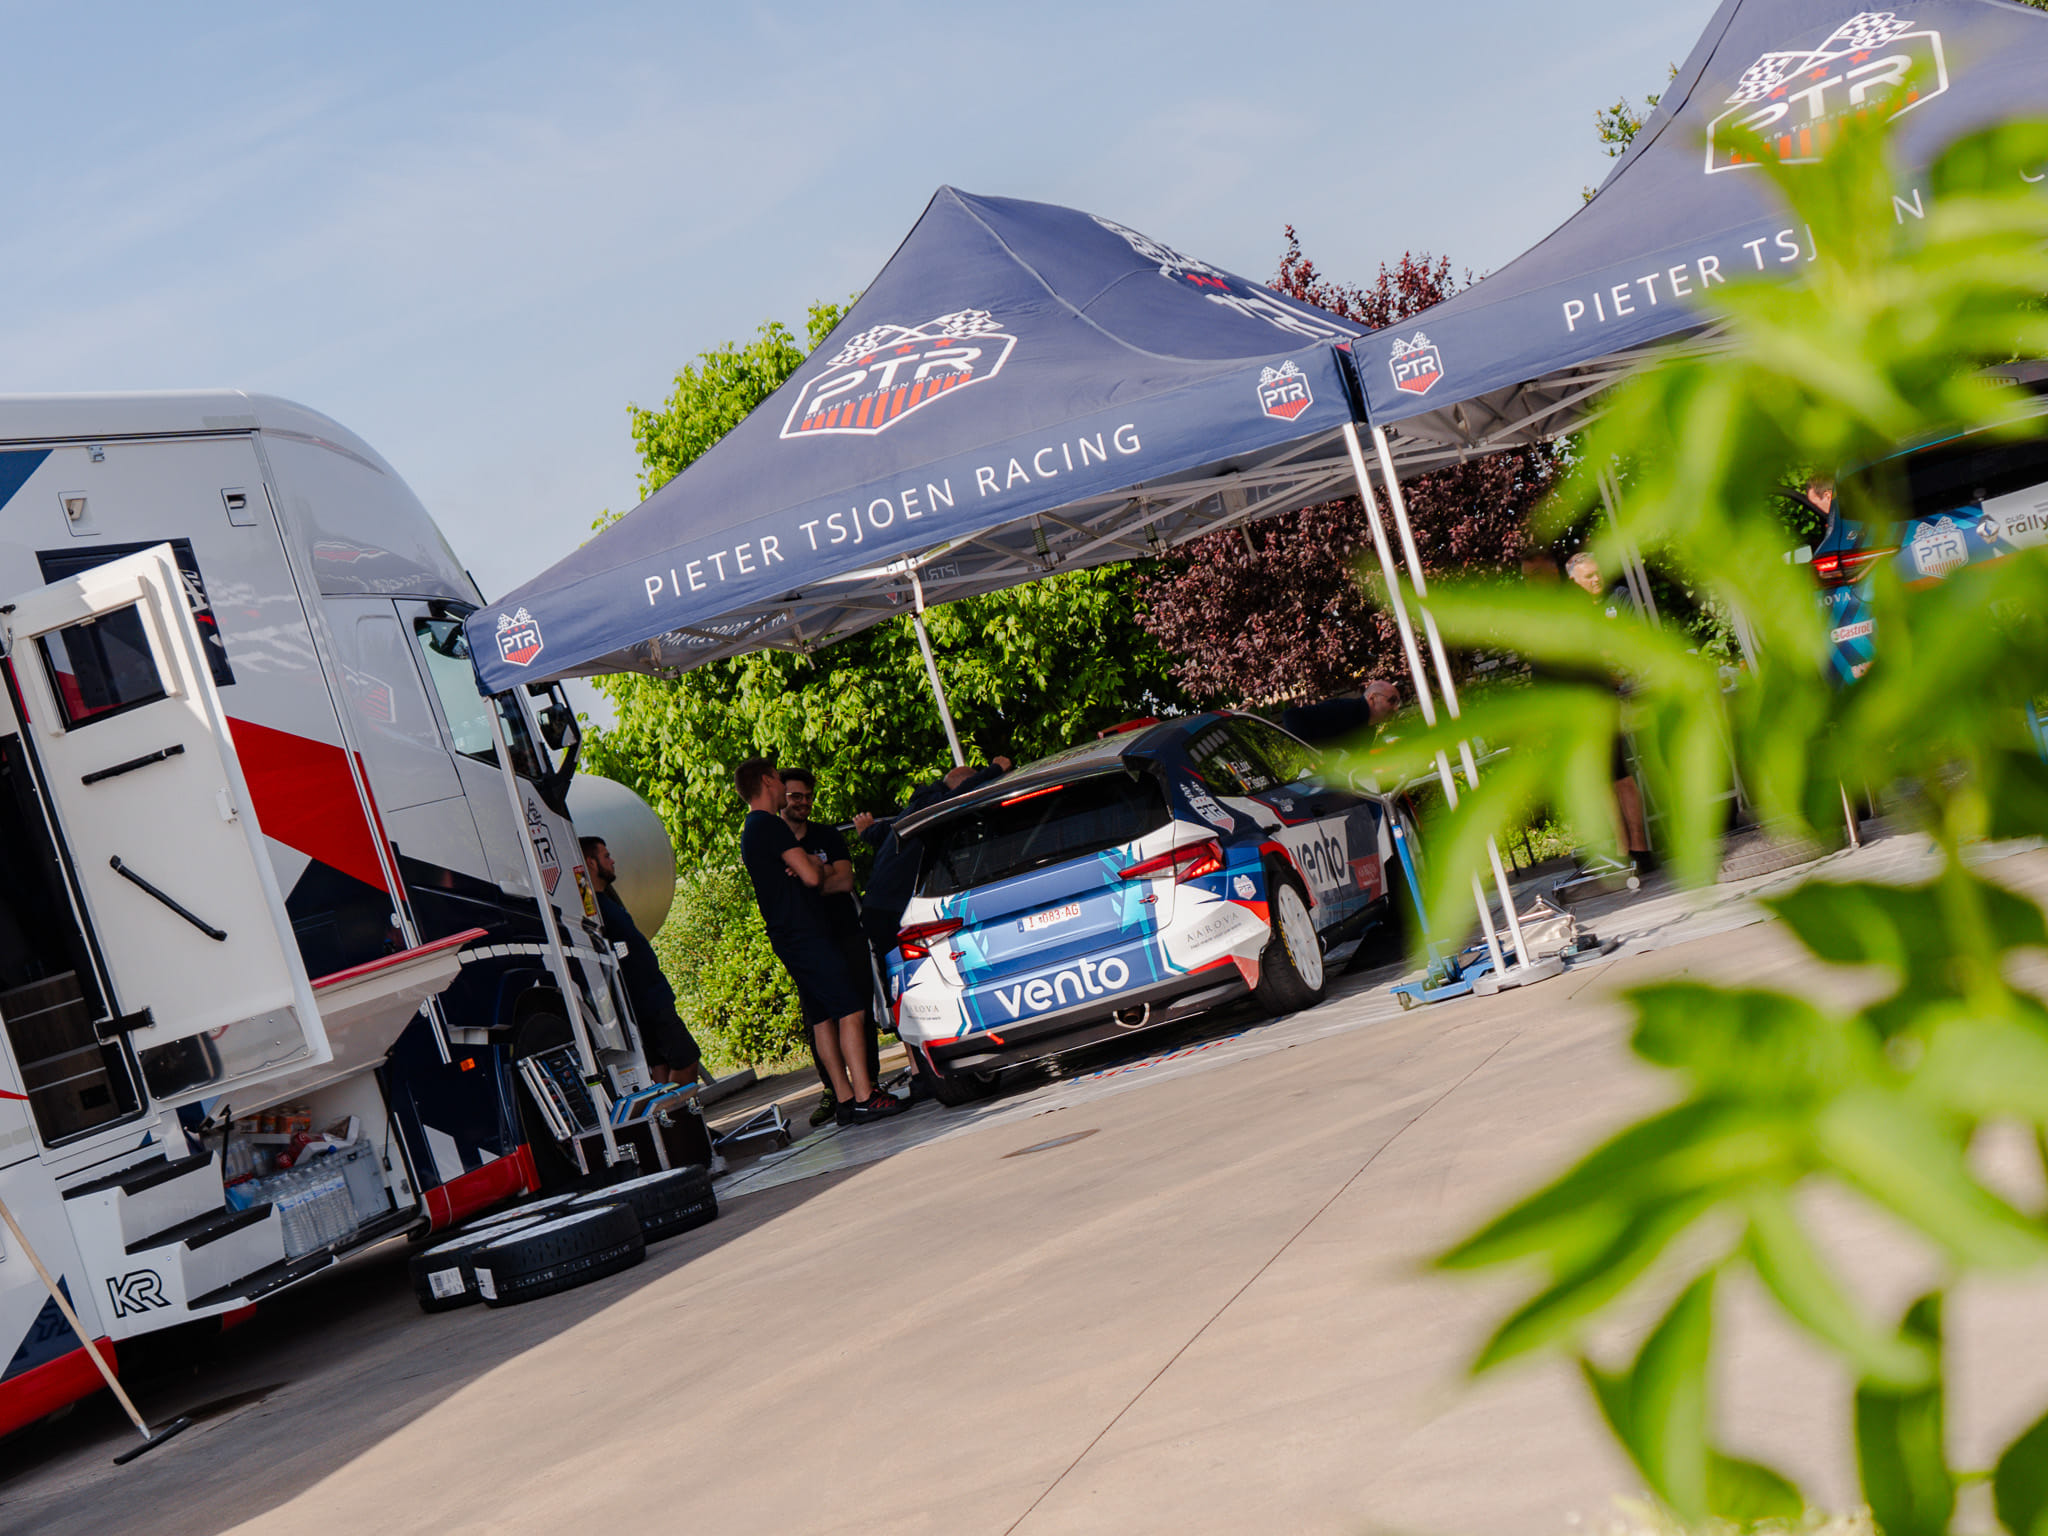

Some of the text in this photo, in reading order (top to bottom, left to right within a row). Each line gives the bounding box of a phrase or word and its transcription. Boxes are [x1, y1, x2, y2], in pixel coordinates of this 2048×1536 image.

[1562, 188, 1926, 332] PIETER TSJN
[806, 347, 982, 414] PTR
[1396, 355, 1437, 382] PTR
[804, 369, 974, 421] PIETER TSJOEN RACING
[1263, 382, 1307, 408] PTR
[644, 423, 1142, 606] PIETER TSJOEN RACING
[1920, 539, 1959, 563] PTR
[501, 629, 538, 654] PTR
[533, 837, 556, 864] TR
[1288, 836, 1345, 885] vento
[994, 957, 1130, 1018] vento
[105, 1269, 172, 1318] KR
